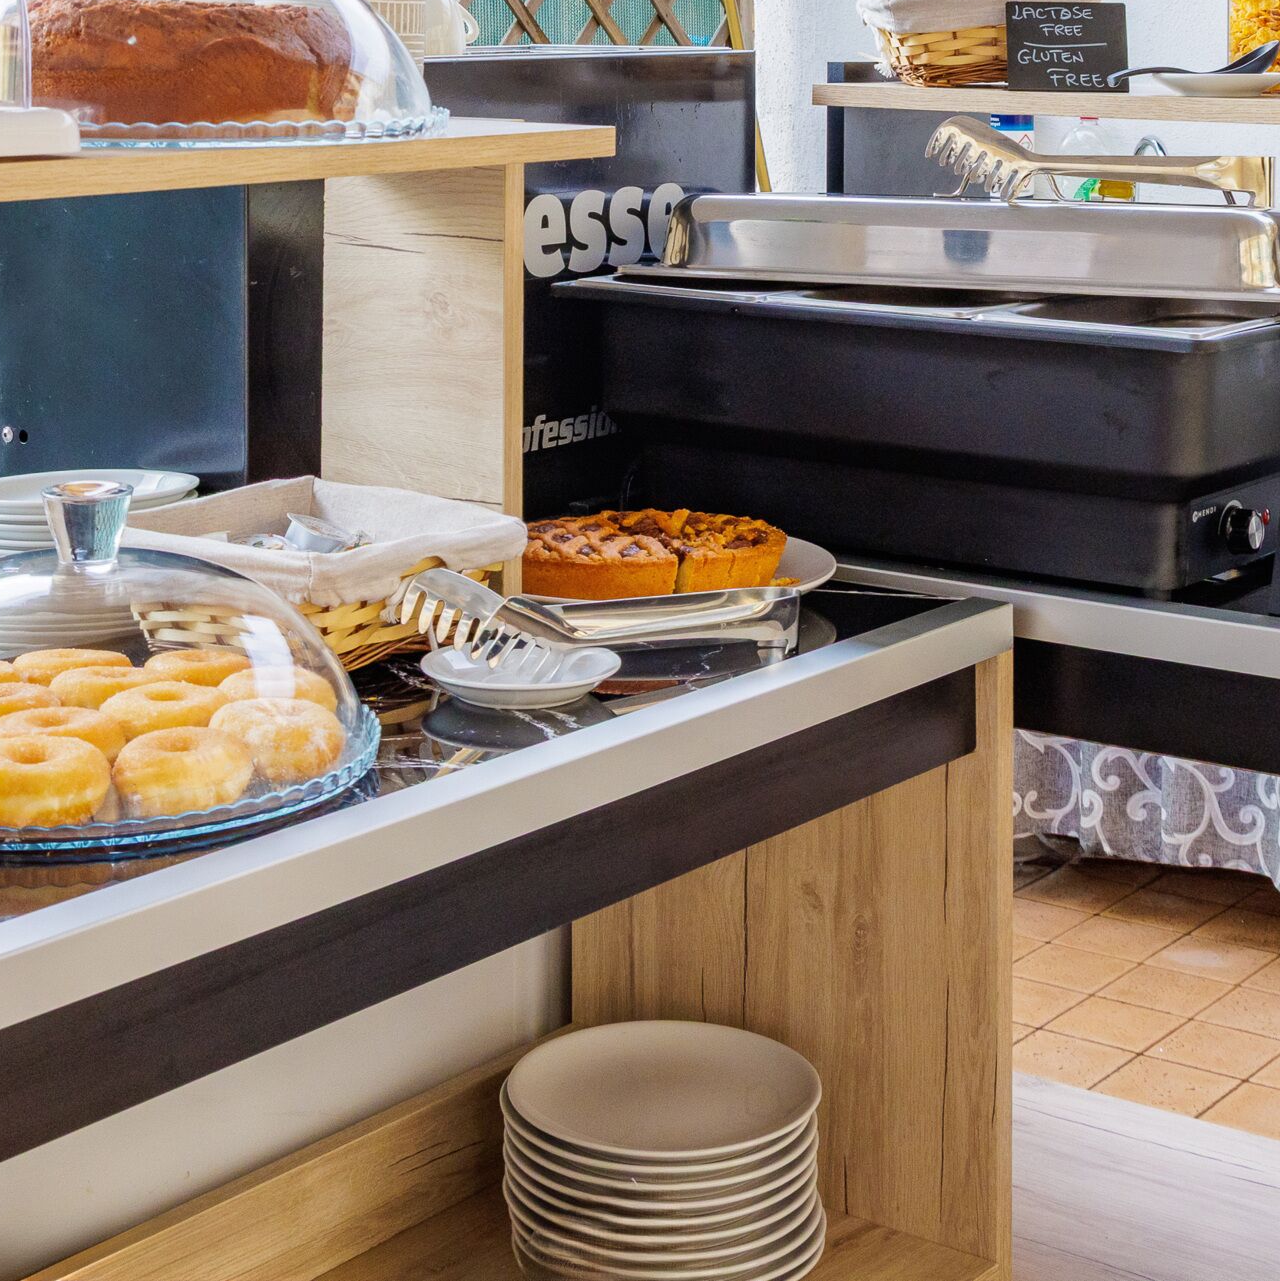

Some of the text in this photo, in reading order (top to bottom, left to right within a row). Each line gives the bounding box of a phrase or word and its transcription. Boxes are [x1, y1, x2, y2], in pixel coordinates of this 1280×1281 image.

[1012, 5, 1094, 20] LACTOSE
[1039, 24, 1083, 37] FREE
[1017, 49, 1085, 65] GLUTEN
[1046, 68, 1105, 88] FREE
